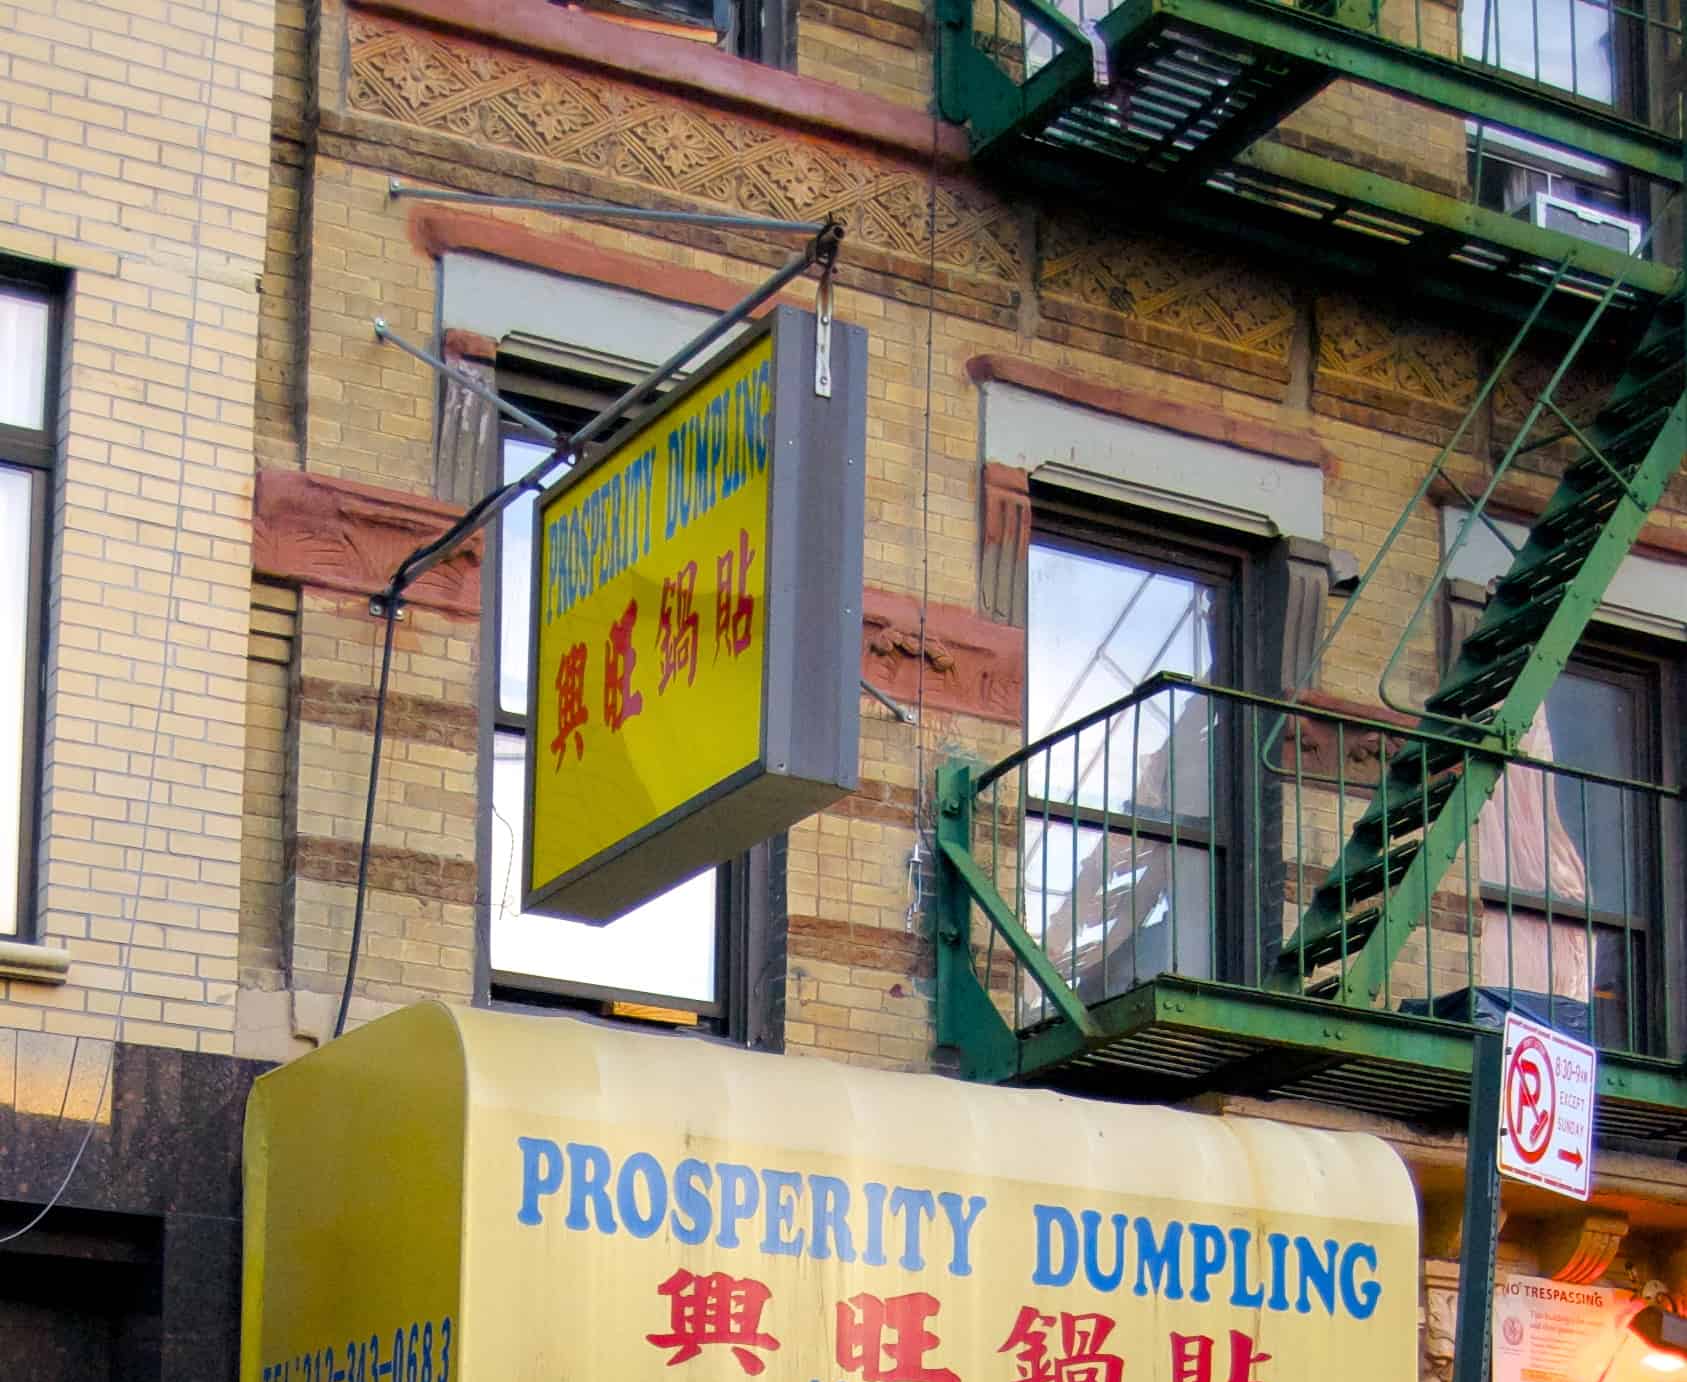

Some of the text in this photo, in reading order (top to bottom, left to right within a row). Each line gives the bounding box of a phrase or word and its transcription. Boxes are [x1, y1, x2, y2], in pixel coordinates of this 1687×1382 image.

[546, 360, 769, 625] PROSPERITY DUMPLING
[1559, 1090, 1585, 1111] EXCEPT
[1557, 1119, 1584, 1138] SUNDAY
[517, 1136, 1383, 1320] PROSPERITY DUMPLING
[1502, 1283, 1604, 1308] NO TRESPASSING
